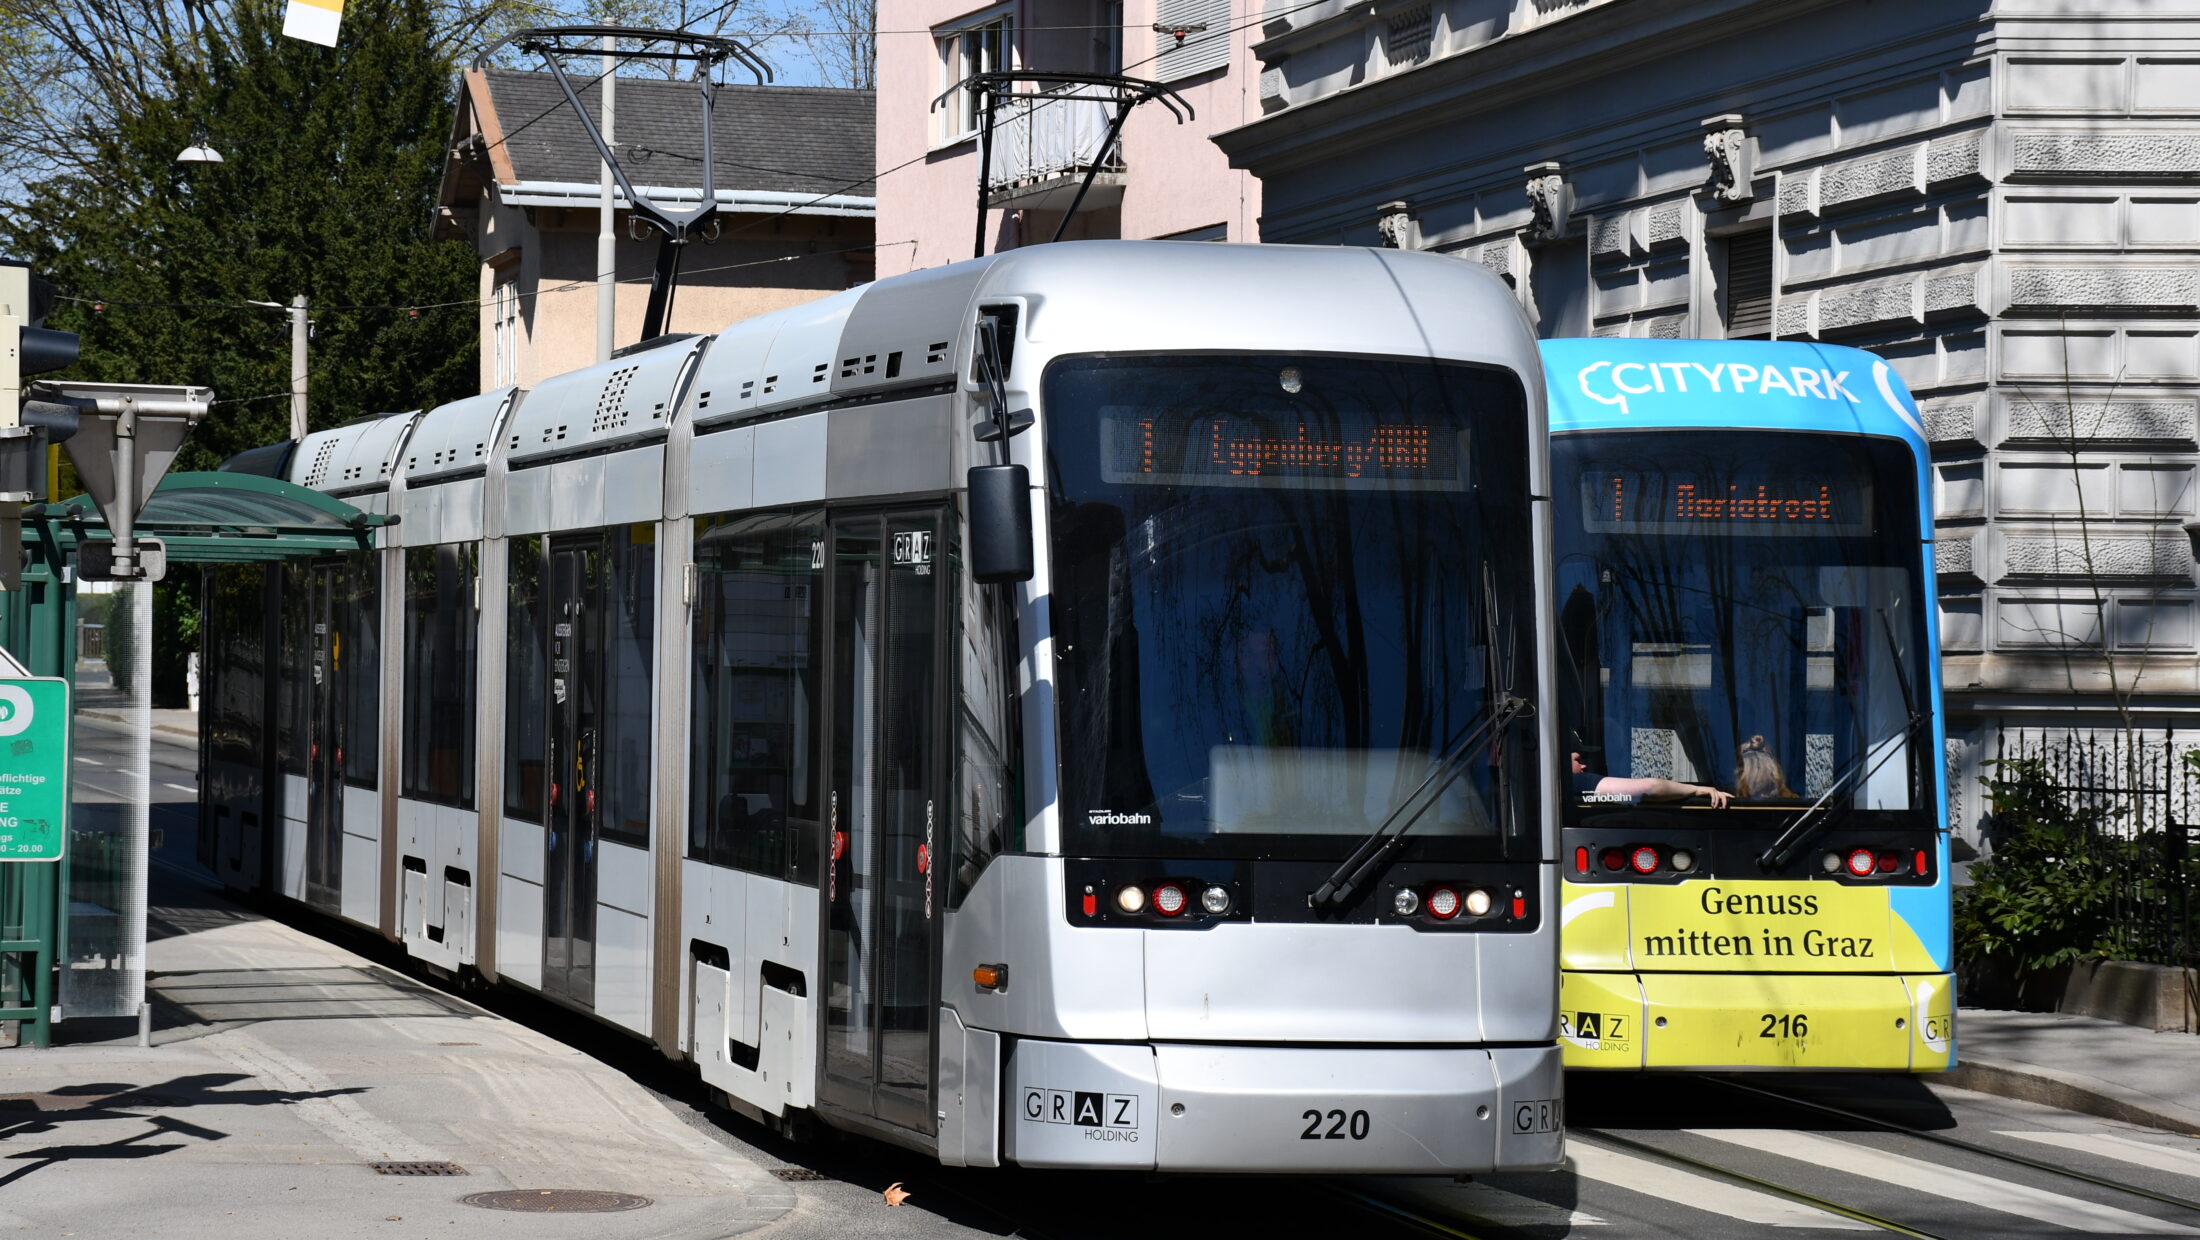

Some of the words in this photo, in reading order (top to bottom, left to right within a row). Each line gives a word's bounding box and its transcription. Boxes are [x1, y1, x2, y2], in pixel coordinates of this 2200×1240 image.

[1611, 361, 1861, 404] CITYPARK
[1138, 418, 1152, 473] 1
[1612, 477, 1623, 522] 1
[1677, 484, 1831, 519] Mariatrost
[811, 541, 825, 569] 220
[894, 531, 931, 564] GRAZ
[0, 773, 46, 785] flichtige
[1582, 792, 1632, 803] variobahn
[1088, 812, 1151, 825] variobahn
[17, 844, 43, 853] 20.00
[1701, 887, 1819, 916] Genuss
[1643, 928, 1752, 956] mitten
[1763, 928, 1796, 956] in
[1803, 929, 1875, 958] Graz
[1760, 1013, 1808, 1039] 216
[1585, 1040, 1630, 1053] HOLDING
[1025, 1087, 1137, 1128] GRAZ
[1084, 1128, 1138, 1143] HOLDING
[1300, 1109, 1370, 1141] 220
